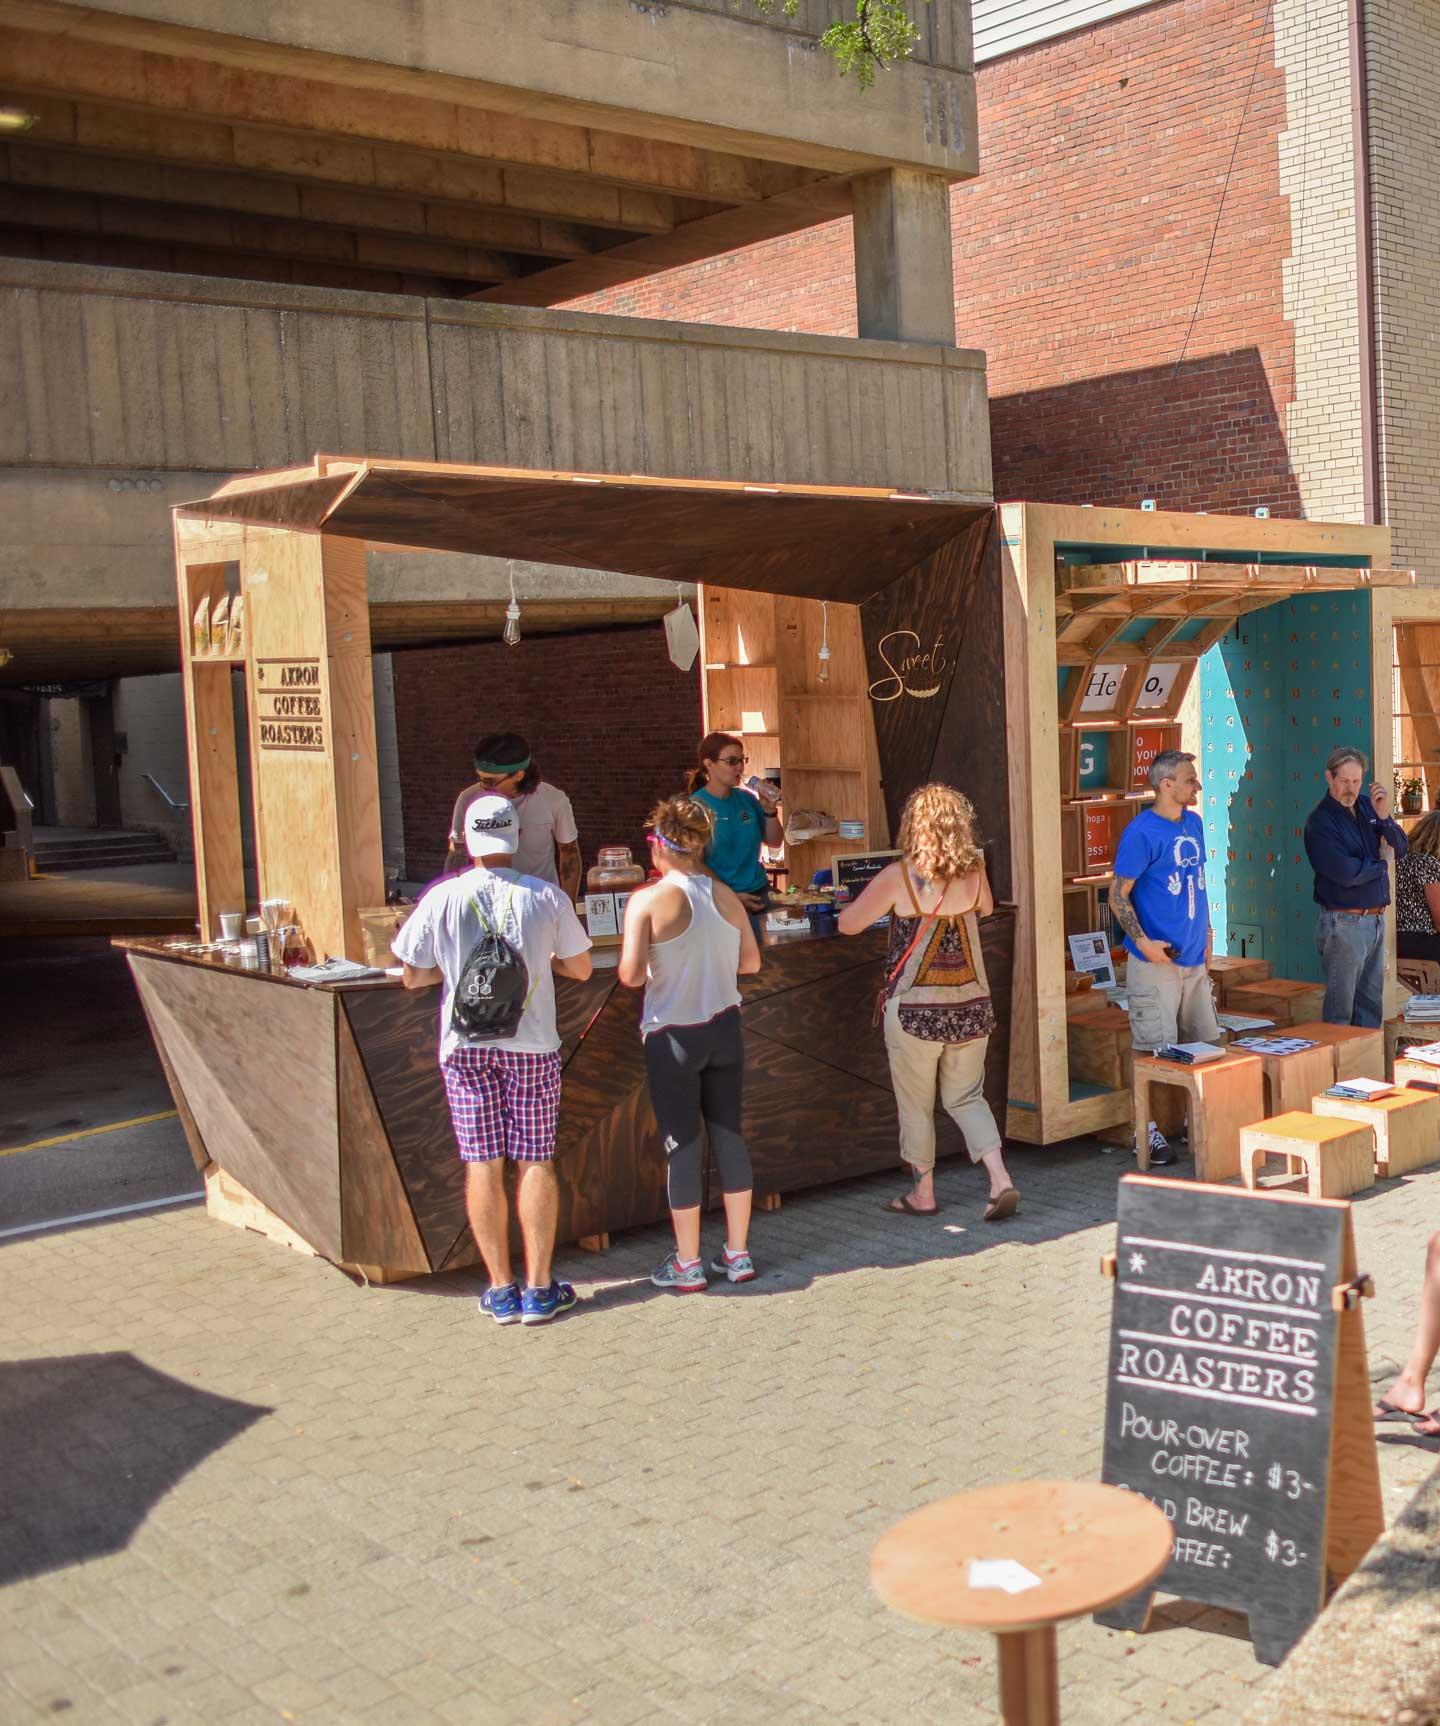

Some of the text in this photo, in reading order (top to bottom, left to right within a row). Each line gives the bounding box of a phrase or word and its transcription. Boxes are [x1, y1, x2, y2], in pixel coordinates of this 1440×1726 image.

[280, 666, 319, 686] AKRON
[869, 630, 946, 701] Sweet
[273, 696, 321, 716] COFFEE
[260, 724, 323, 745] ROASTERS
[1136, 749, 1157, 763] you
[471, 818, 513, 831] Titleist
[1196, 1264, 1321, 1307] AKRON
[1170, 1305, 1319, 1359] COFFEE
[1118, 1344, 1316, 1403] ROASTERS
[1120, 1401, 1250, 1459] POUR-OVER
[1151, 1449, 1254, 1488] COFFEE:
[1185, 1496, 1249, 1537] BREW
[1171, 1537, 1232, 1569] FFEE:
